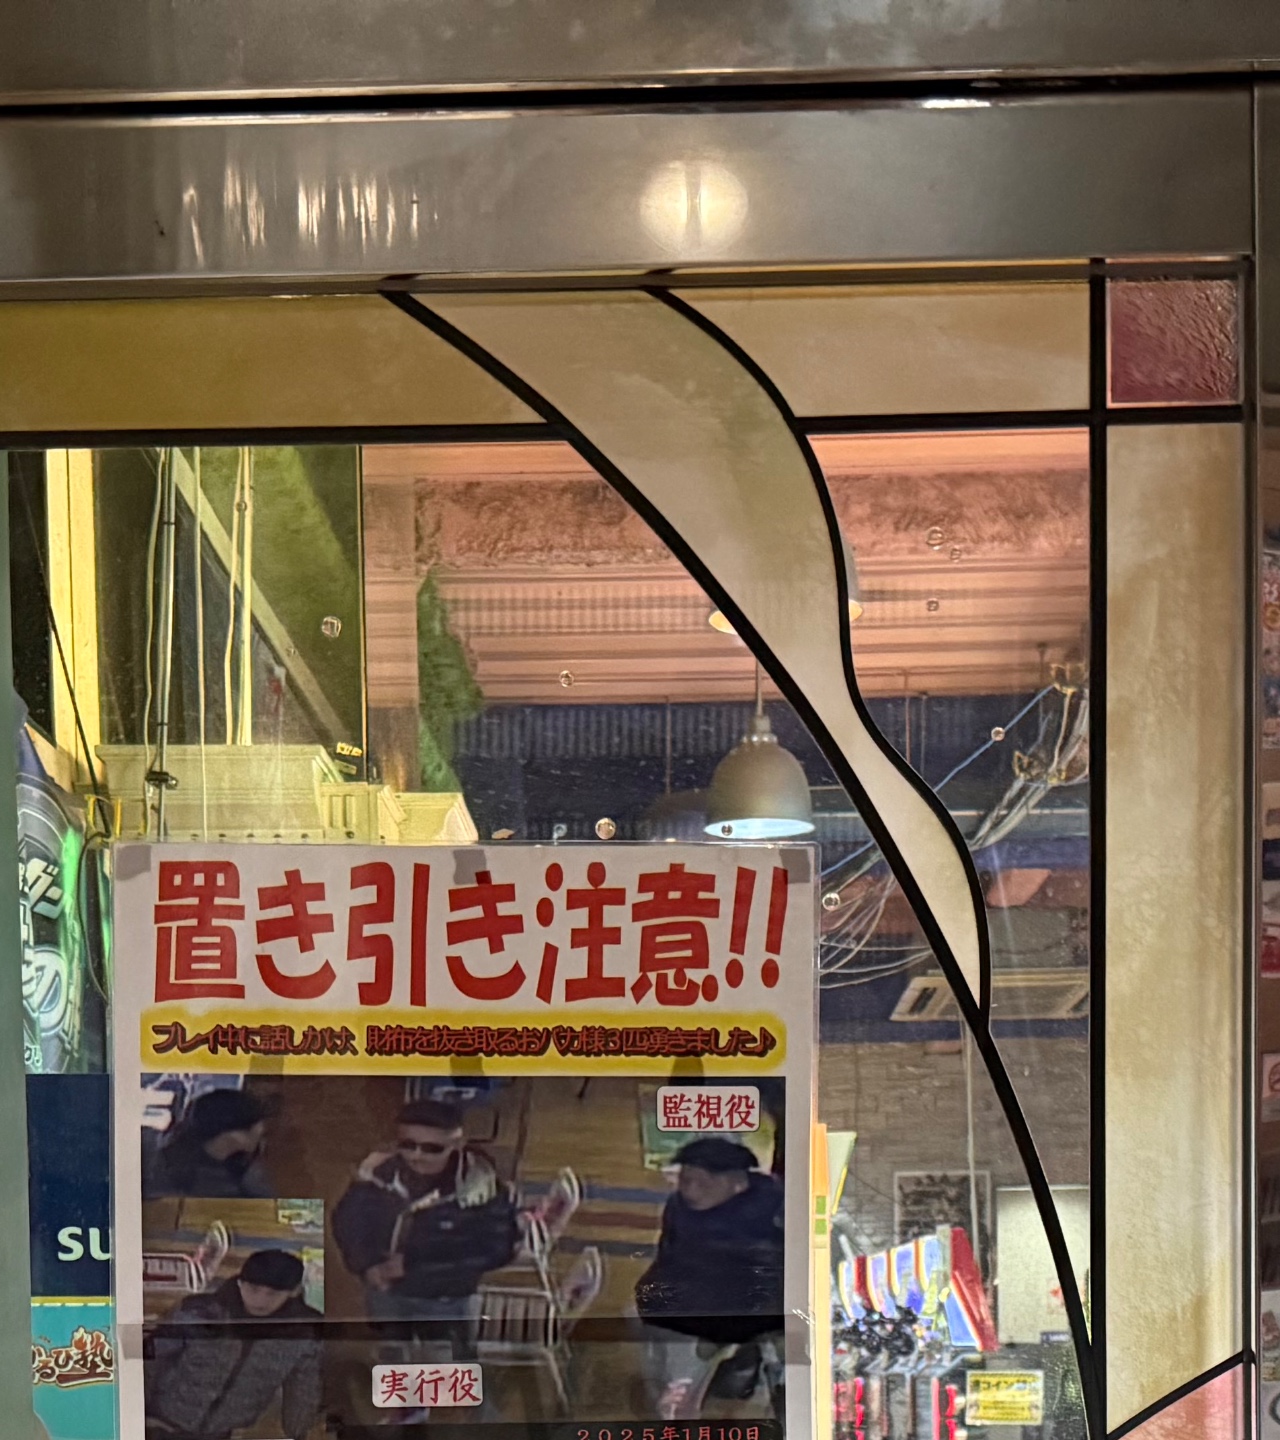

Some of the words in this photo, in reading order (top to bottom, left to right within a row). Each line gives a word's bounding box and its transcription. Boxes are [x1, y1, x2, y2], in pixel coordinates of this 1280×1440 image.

[662, 1094, 756, 1129] 監視役
[379, 1369, 481, 1404] 実行役
